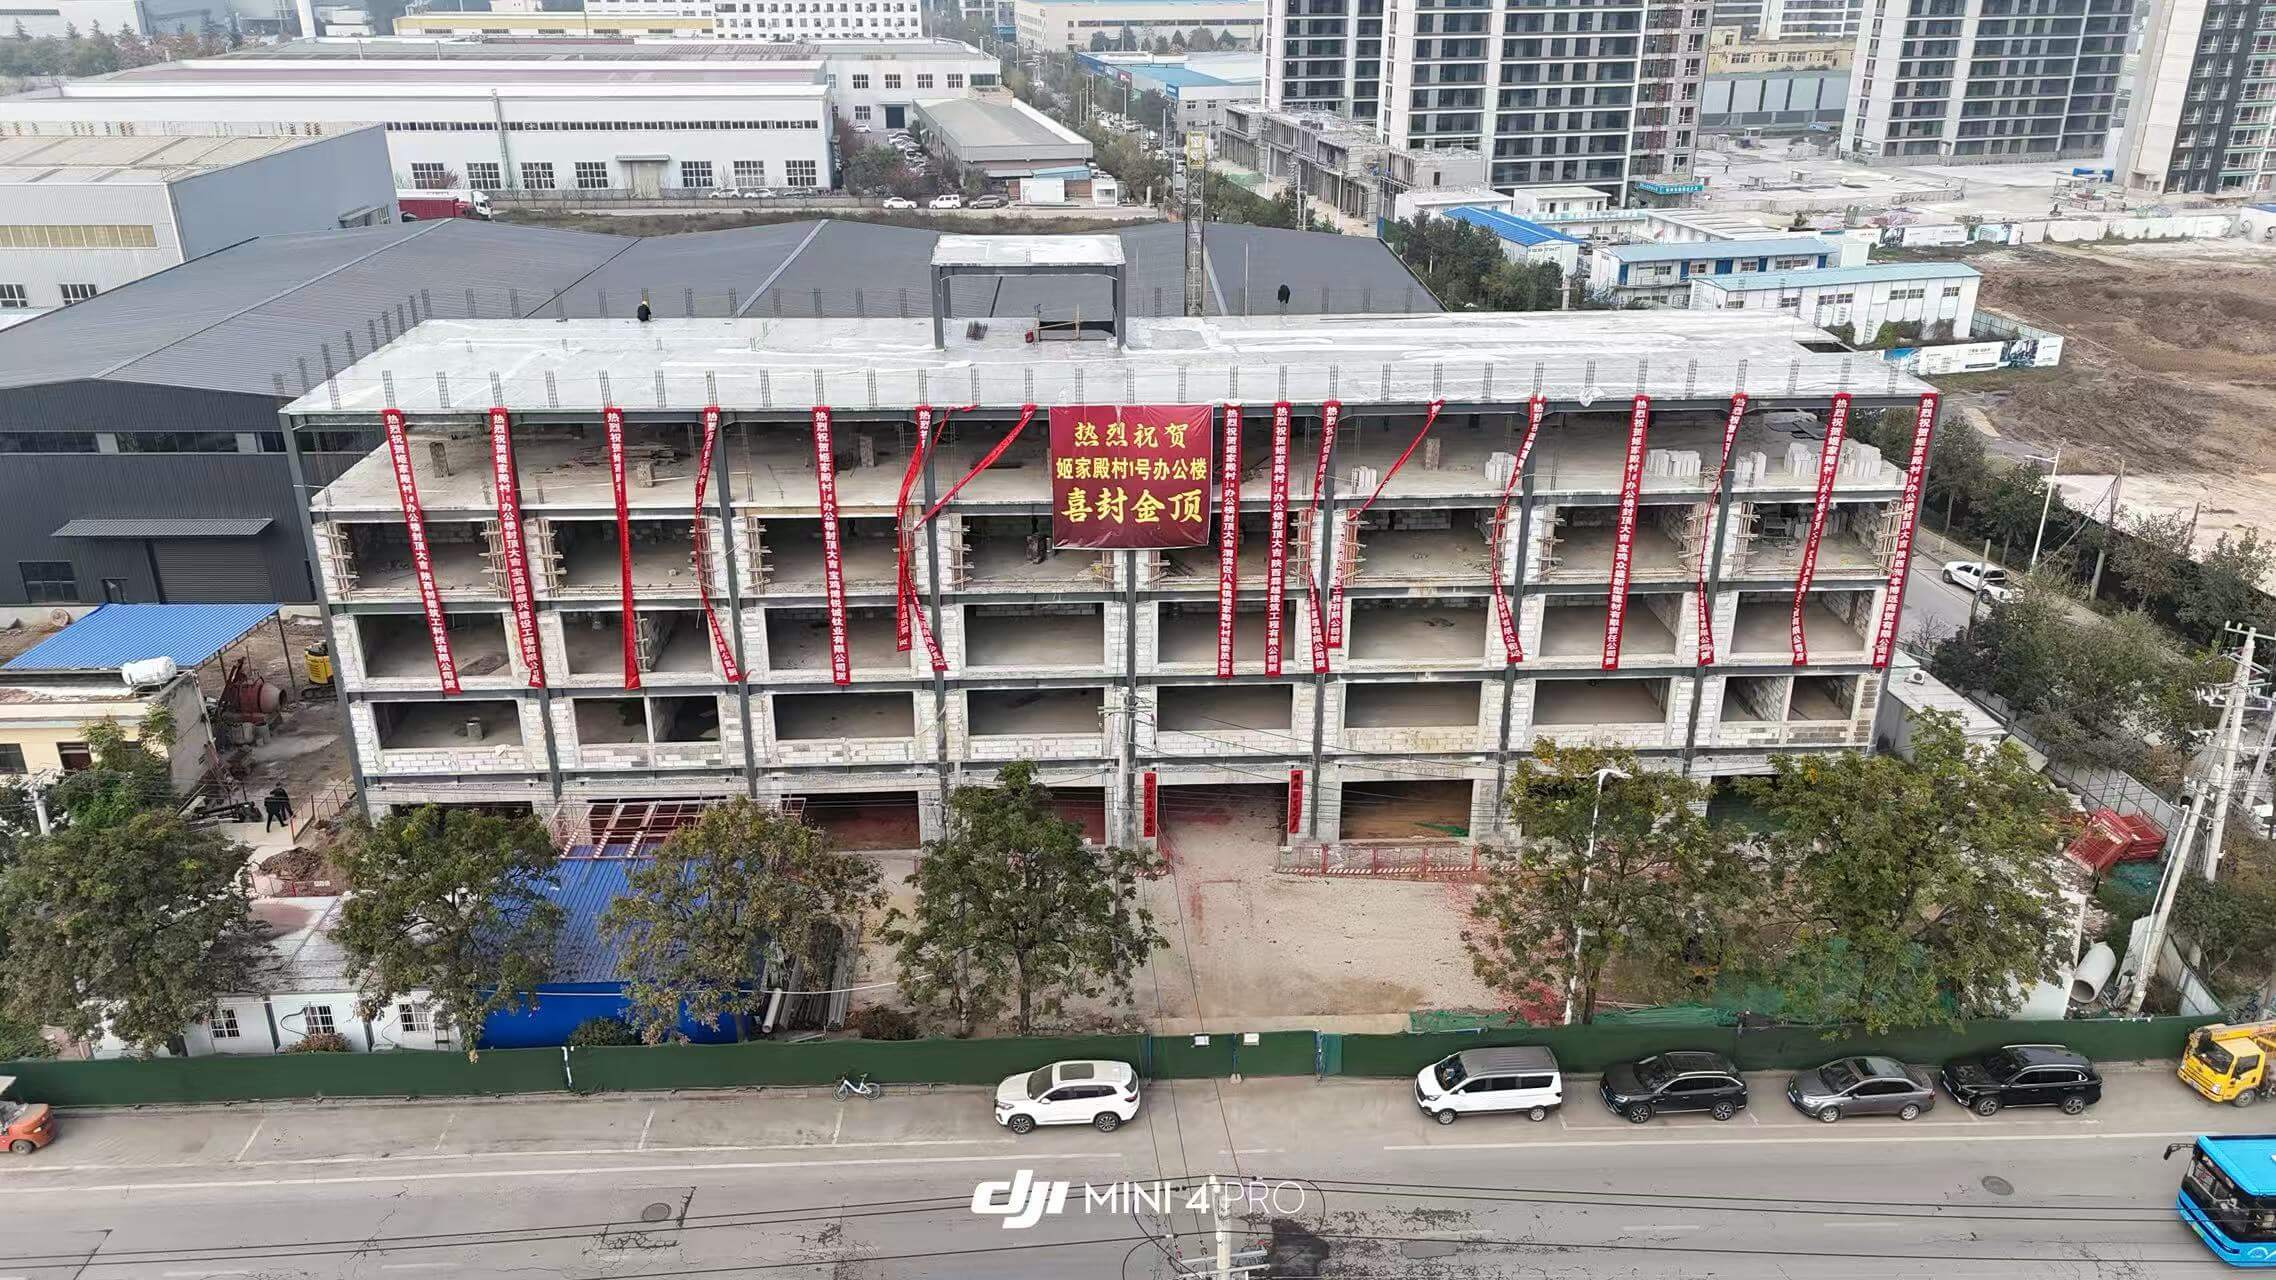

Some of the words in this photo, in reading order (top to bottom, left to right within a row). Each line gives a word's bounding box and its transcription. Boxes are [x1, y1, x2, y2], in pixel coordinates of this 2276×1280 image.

[1074, 422, 1190, 449] 热烈祝贺
[1056, 457, 1207, 481] 姬家殿村1号办公楼
[1061, 487, 1203, 524] 喜封金顶
